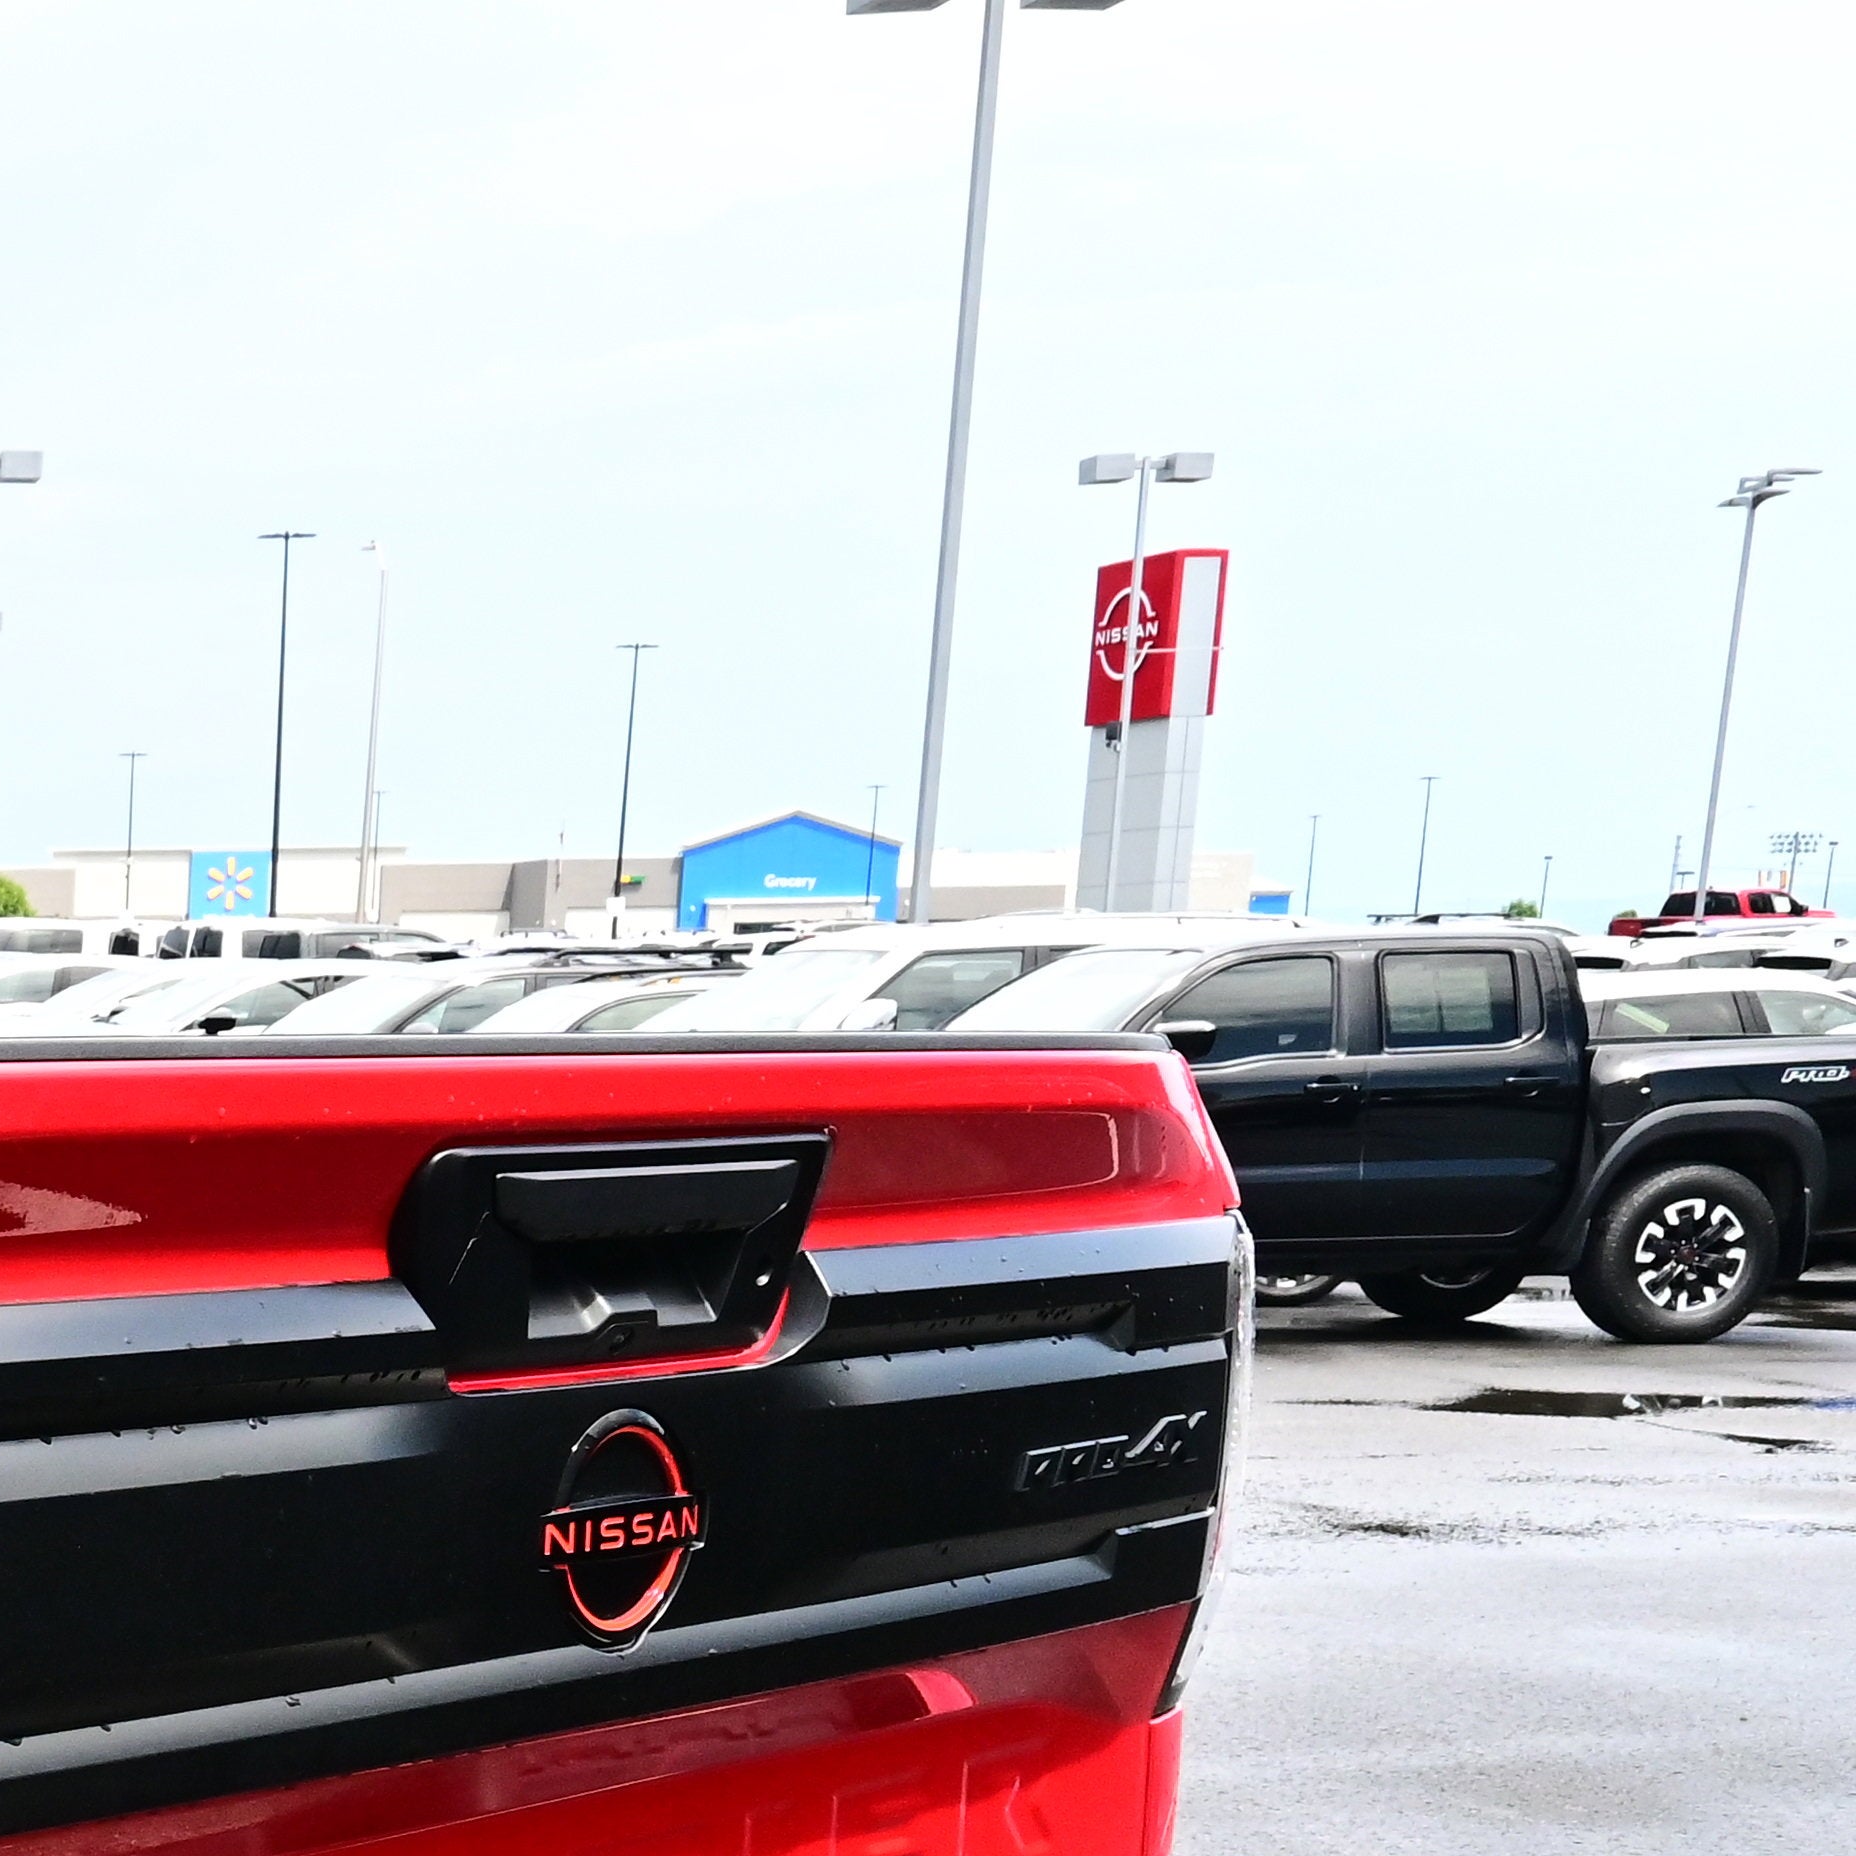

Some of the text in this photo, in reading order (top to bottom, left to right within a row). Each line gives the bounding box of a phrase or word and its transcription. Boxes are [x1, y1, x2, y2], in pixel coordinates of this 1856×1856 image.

[1095, 620, 1159, 647] NISSAN
[764, 873, 817, 891] Grocery
[542, 1502, 699, 1557] NISSAN
